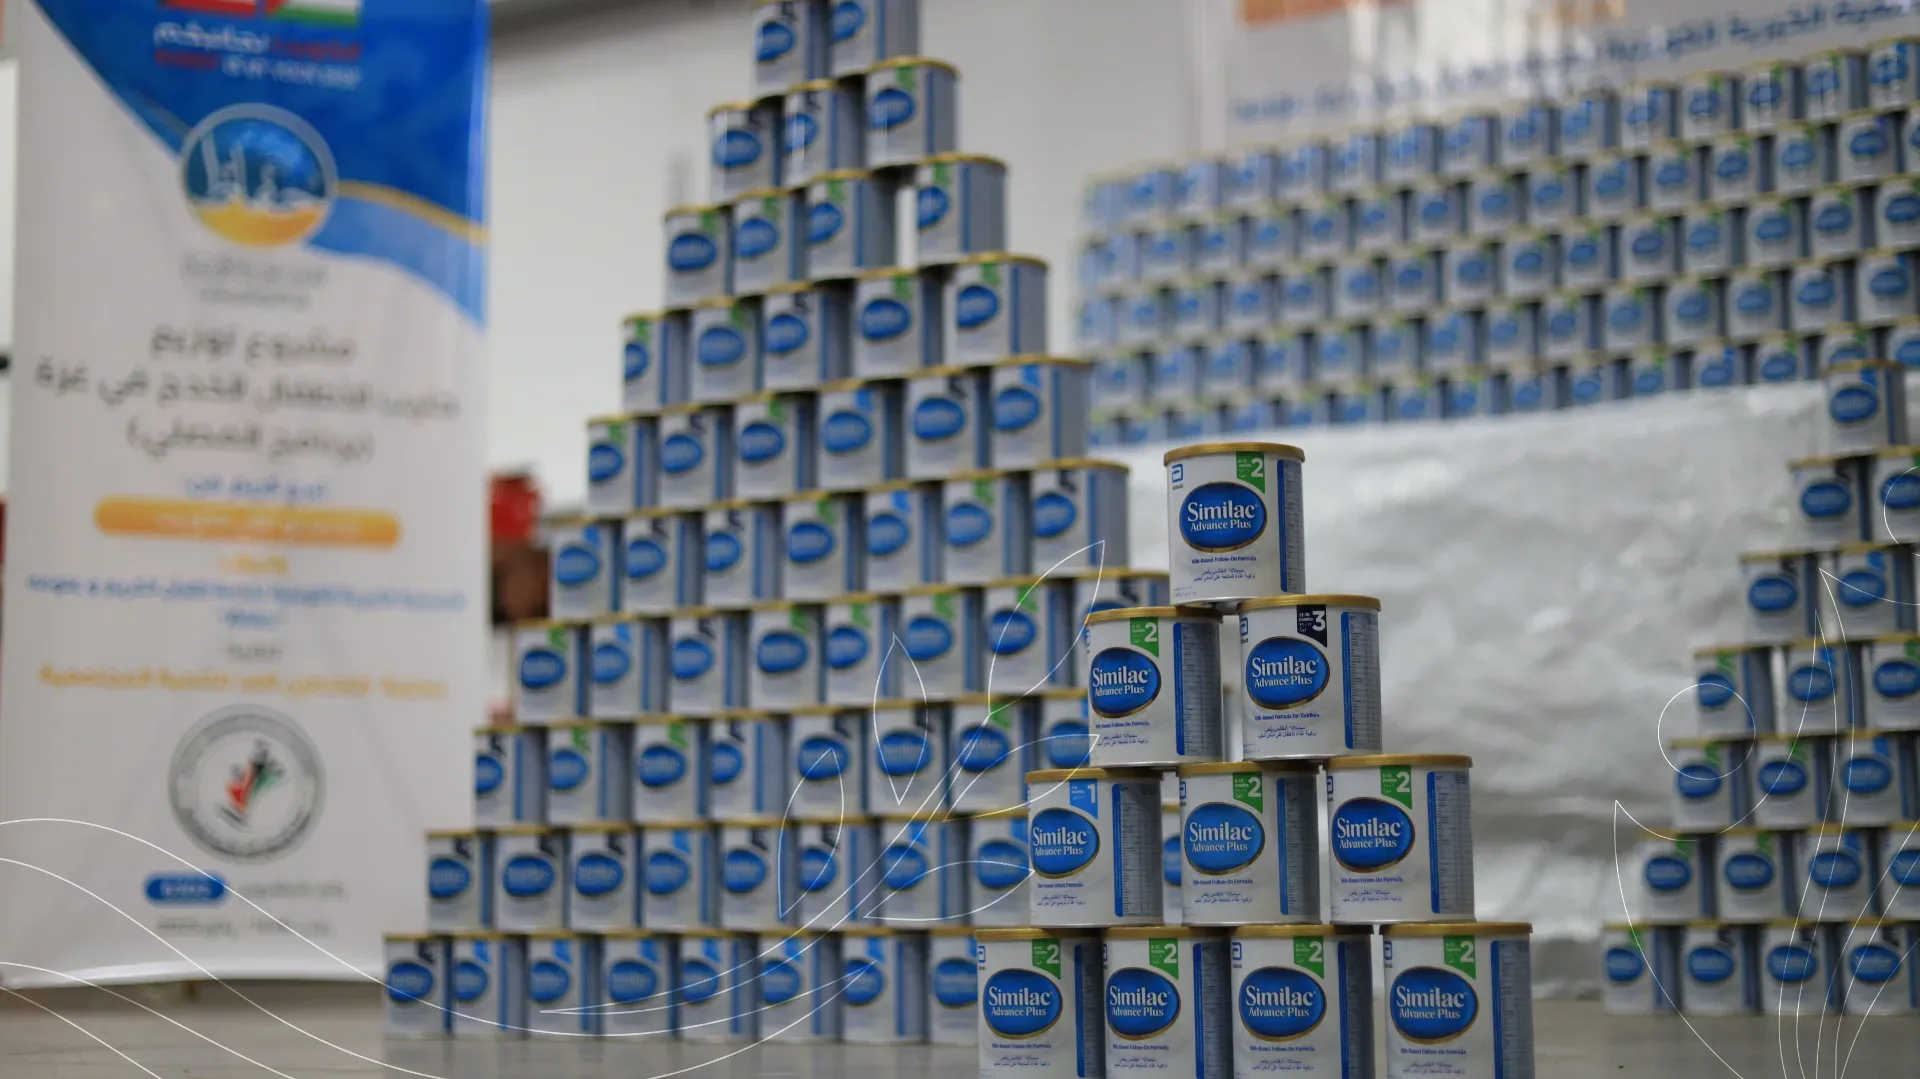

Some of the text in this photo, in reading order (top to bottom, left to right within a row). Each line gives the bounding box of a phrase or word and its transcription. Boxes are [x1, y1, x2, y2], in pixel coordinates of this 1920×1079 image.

[1251, 457, 1264, 478] 2
[1187, 500, 1255, 522] Similac
[1190, 519, 1252, 532] Advance Plus
[1312, 610, 1326, 631] 3
[1144, 622, 1158, 643] 2
[1092, 665, 1149, 688] Similac
[1252, 655, 1317, 678] Similac
[1094, 684, 1145, 697] Advance Plus
[1254, 675, 1313, 688] Advance Plus
[1247, 776, 1262, 798] 2
[1396, 771, 1411, 793] 2
[1087, 783, 1096, 804] 1
[1032, 826, 1087, 847] Similac
[1189, 821, 1252, 842] Similac
[1337, 817, 1402, 839] Similac
[1035, 846, 1083, 857] Advance Plus
[1192, 841, 1248, 853] Advance Plus
[1339, 838, 1397, 849] Advance Plus
[1046, 943, 1060, 965] 2
[1163, 943, 1178, 964] 2
[1308, 941, 1323, 963] 2
[1459, 941, 1475, 963] 2
[988, 986, 1051, 1006] Similac
[1109, 985, 1168, 1007] Similac
[1245, 985, 1314, 1006] Similac
[1396, 985, 1465, 1008] Similac
[991, 1006, 1047, 1017] Advance Plus
[1111, 1006, 1164, 1017] Advance Plus
[1248, 1006, 1310, 1017] Advance Plus
[1399, 1008, 1460, 1019] Advance Plus
